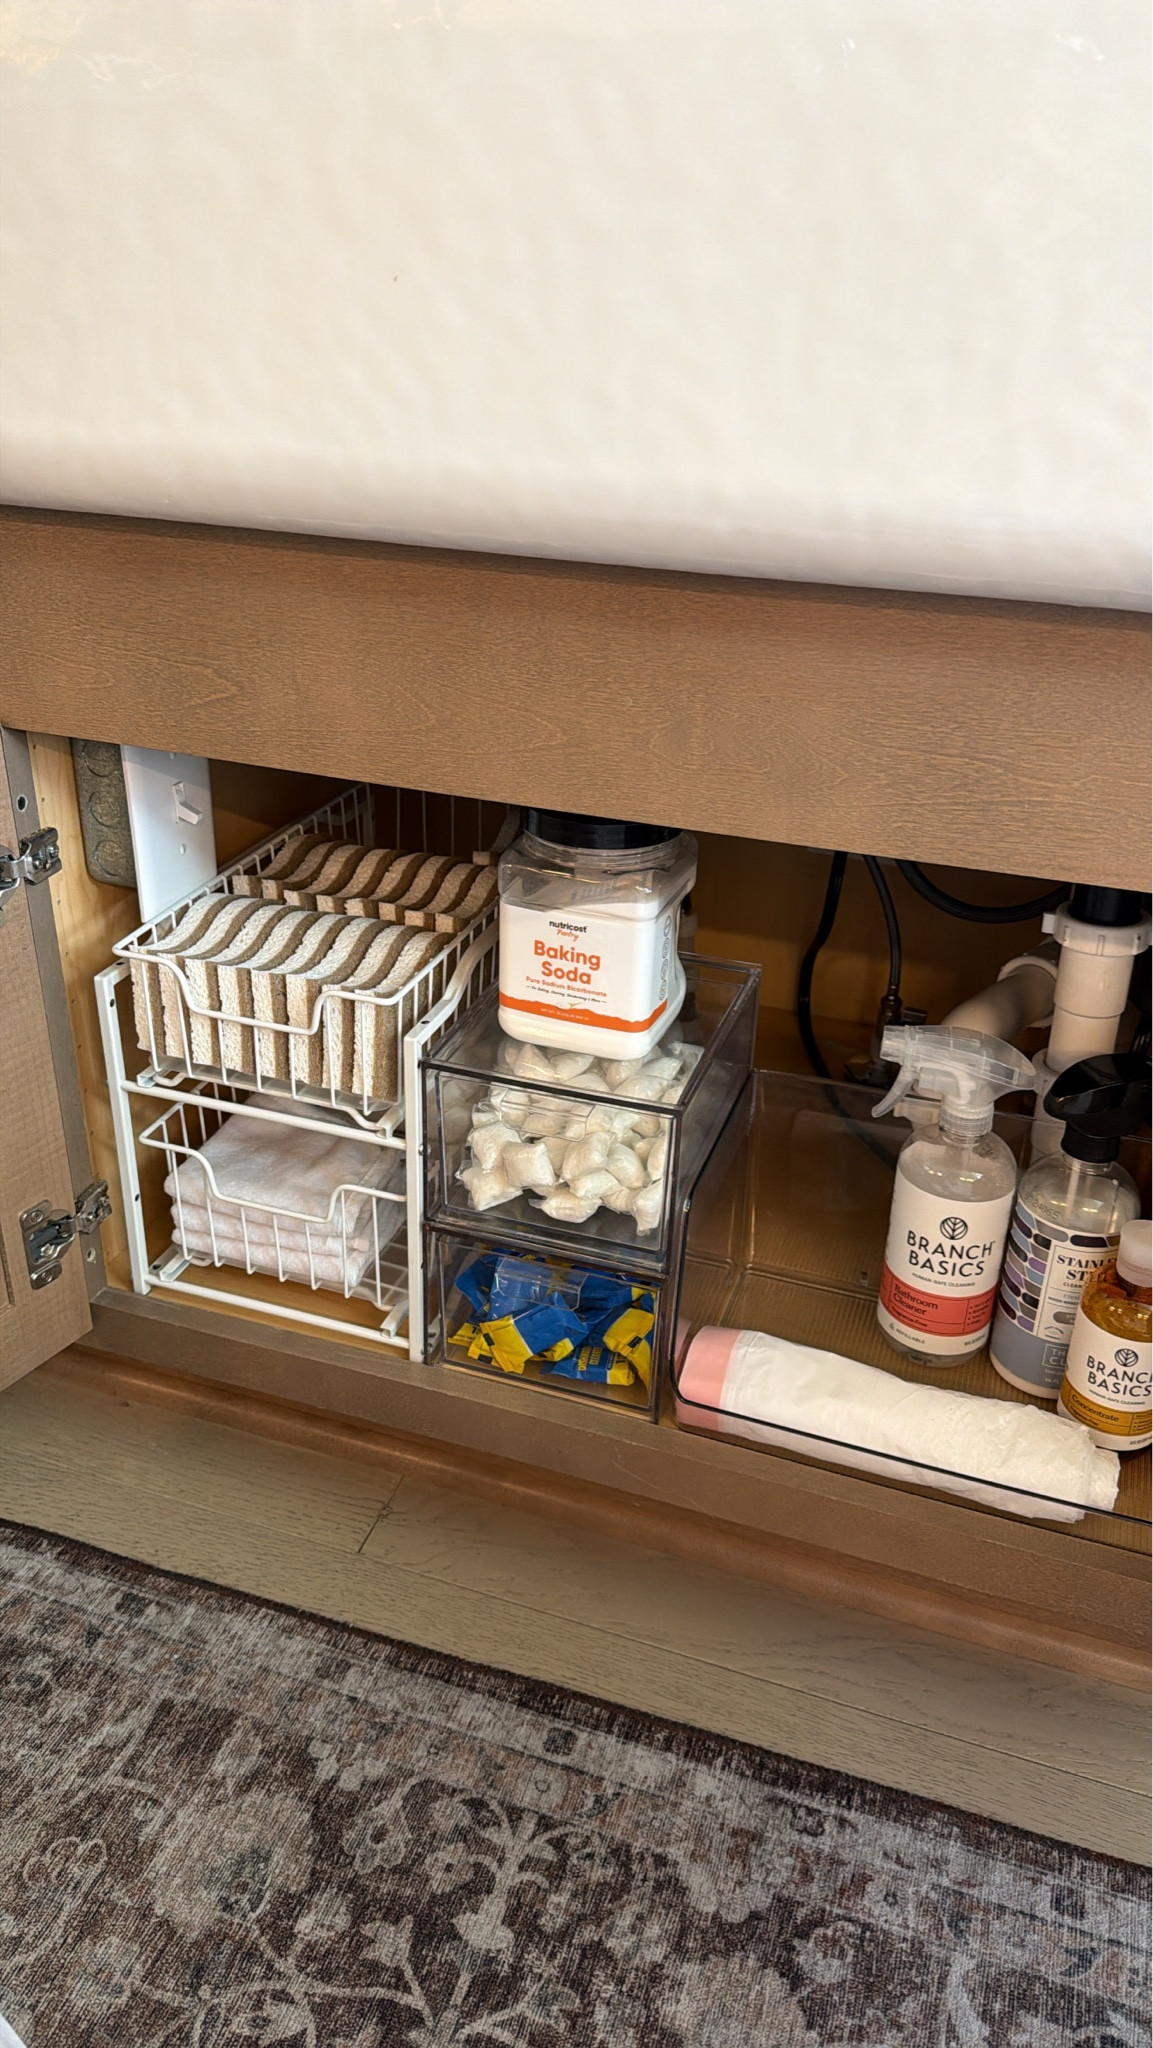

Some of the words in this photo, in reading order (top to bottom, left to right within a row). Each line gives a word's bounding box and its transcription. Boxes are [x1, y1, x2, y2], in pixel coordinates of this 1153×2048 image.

[549, 921, 587, 933] nutricost
[534, 940, 601, 971] Baking
[541, 960, 592, 985] Soda
[526, 975, 541, 985] Pure
[541, 980, 566, 990] Sodium
[566, 985, 607, 997] Bicarbonate
[907, 1230, 994, 1260] BRANCH
[908, 1250, 985, 1277] BASICS
[893, 1293, 928, 1316] Cleaner
[894, 1284, 938, 1310] Bathroom
[1088, 1371, 1152, 1397] BASICS
[1072, 1394, 1119, 1422] Concentrate
